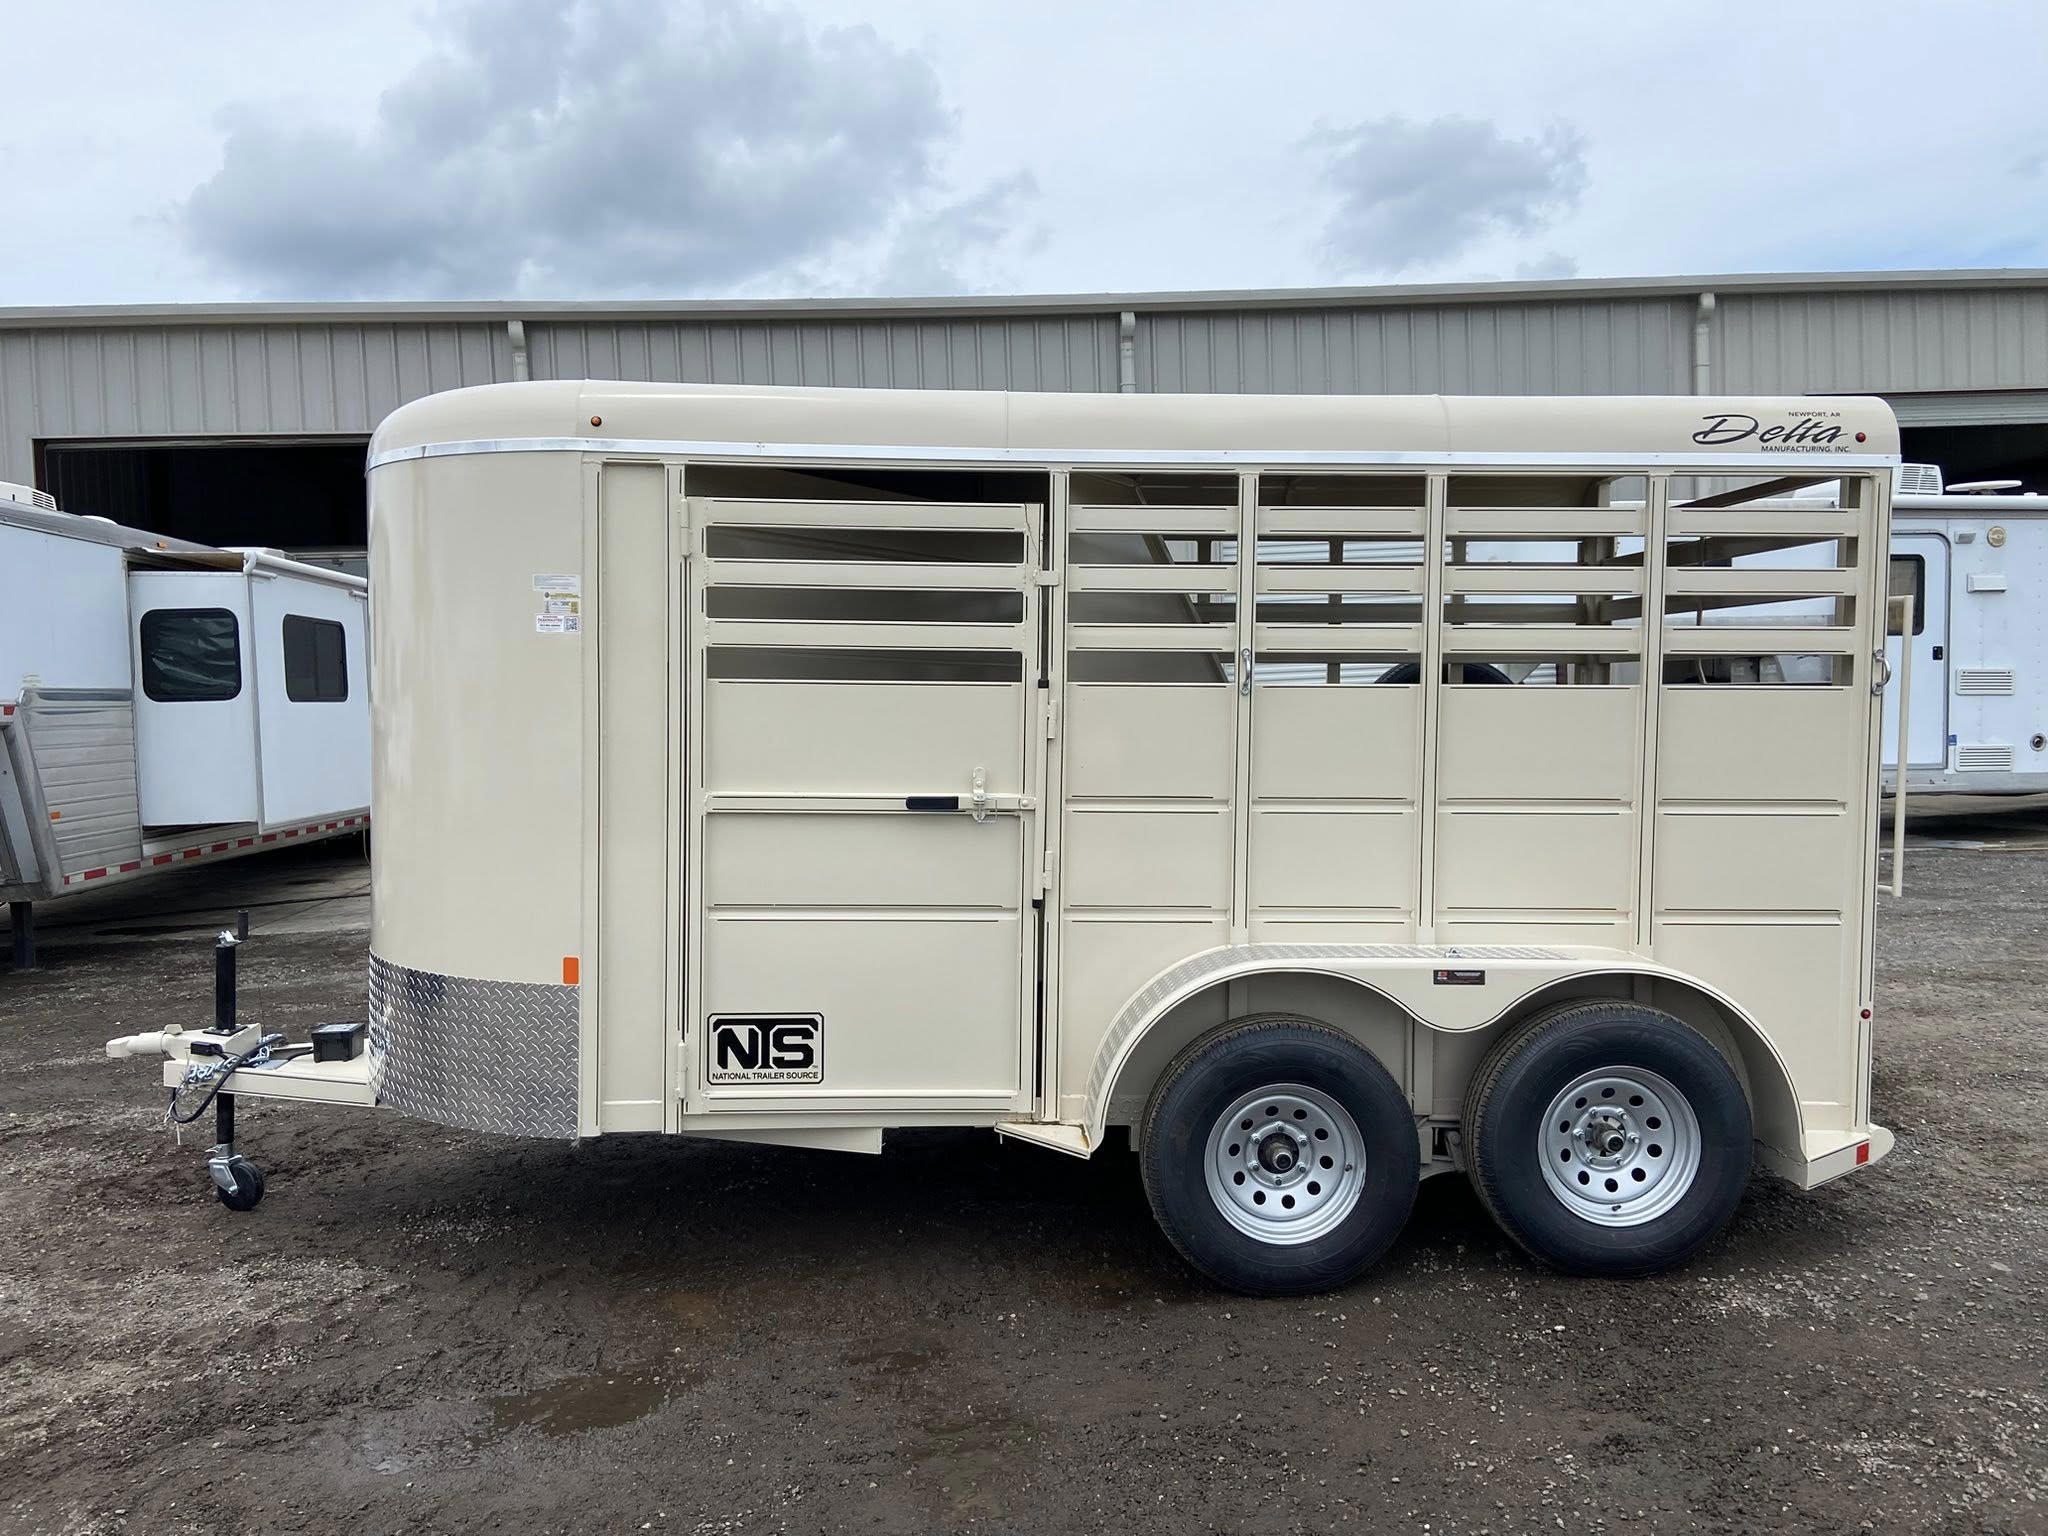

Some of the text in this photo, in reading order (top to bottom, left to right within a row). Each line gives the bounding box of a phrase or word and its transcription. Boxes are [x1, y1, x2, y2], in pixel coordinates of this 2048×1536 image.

[1692, 414, 1849, 445] Delta
[712, 1017, 819, 1070] NTS
[712, 1071, 818, 1080] NATIONAL TRAILER SOURCE
